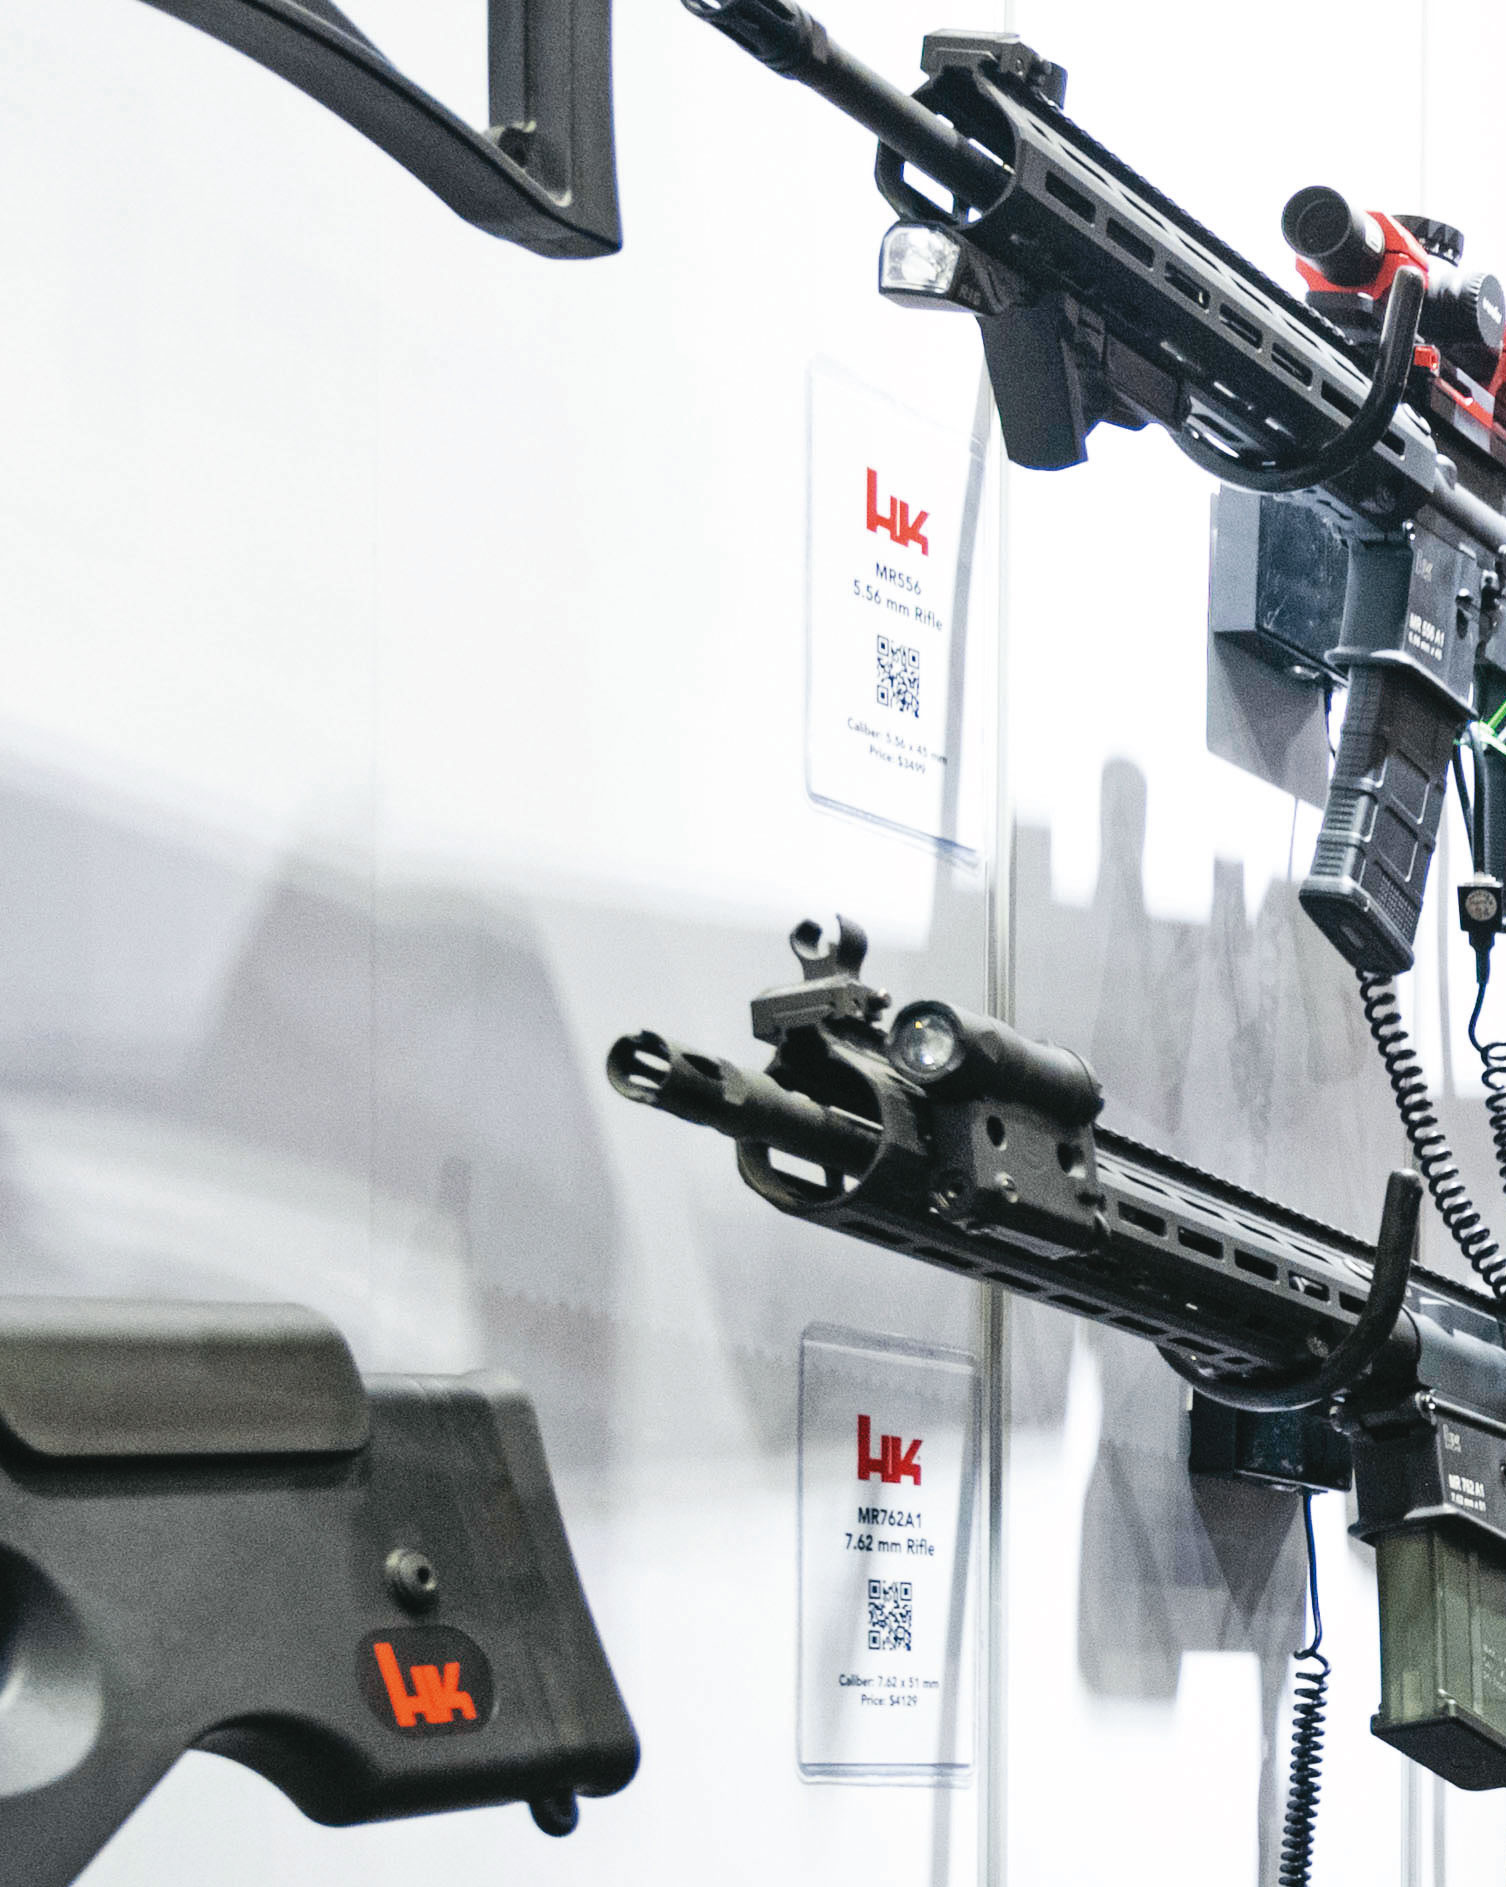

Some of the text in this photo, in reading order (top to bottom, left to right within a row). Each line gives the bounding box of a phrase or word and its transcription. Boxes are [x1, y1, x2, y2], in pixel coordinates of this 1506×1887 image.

[867, 466, 930, 557] HK
[875, 562, 922, 595] MR556
[854, 579, 943, 630] 5.56 mm Rifle
[857, 1414, 924, 1486] HK
[858, 1507, 922, 1528] MR762A1
[845, 1533, 935, 1556] 7.62 mm Rifle
[374, 1641, 477, 1727] HK
